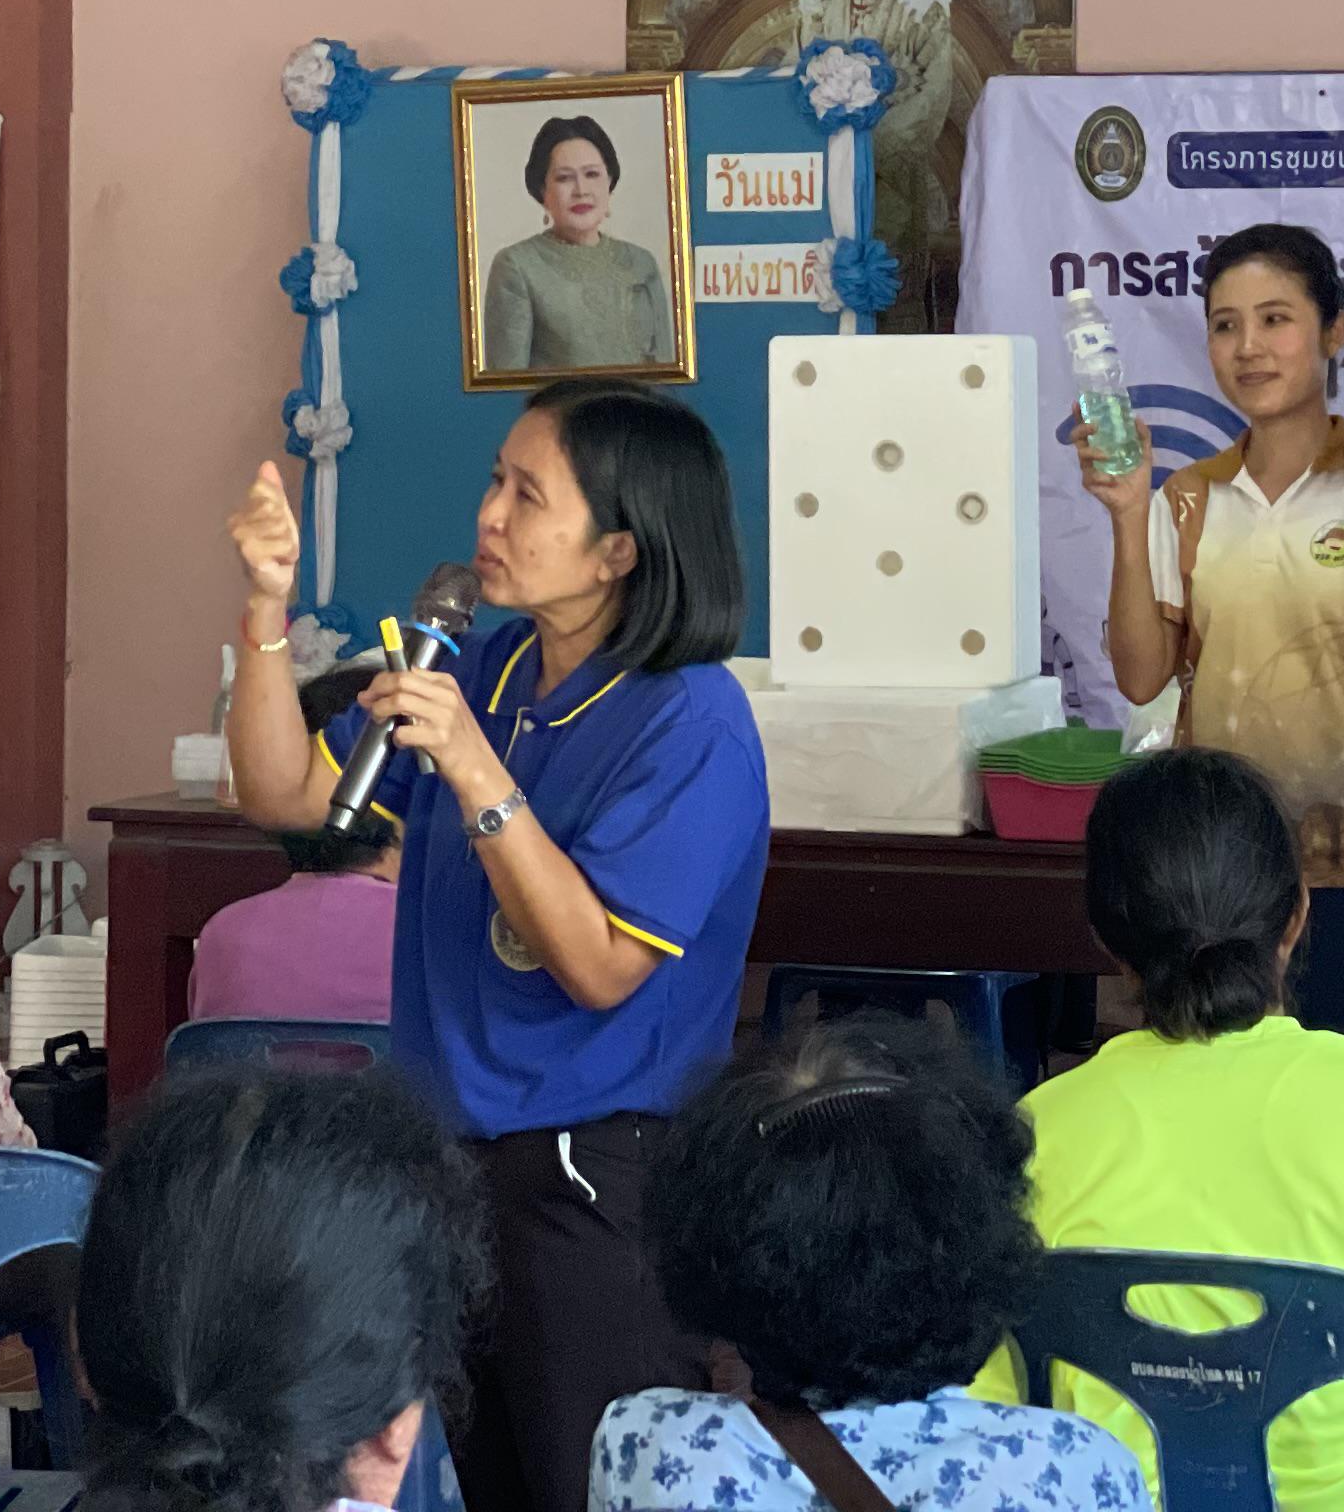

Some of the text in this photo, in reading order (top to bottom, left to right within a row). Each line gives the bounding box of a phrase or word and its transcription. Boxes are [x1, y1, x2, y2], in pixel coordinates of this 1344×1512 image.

[715, 157, 814, 207] วันแม่
[703, 249, 817, 296] แห่งชาติ
[1247, 1370, 1261, 1385] 17
